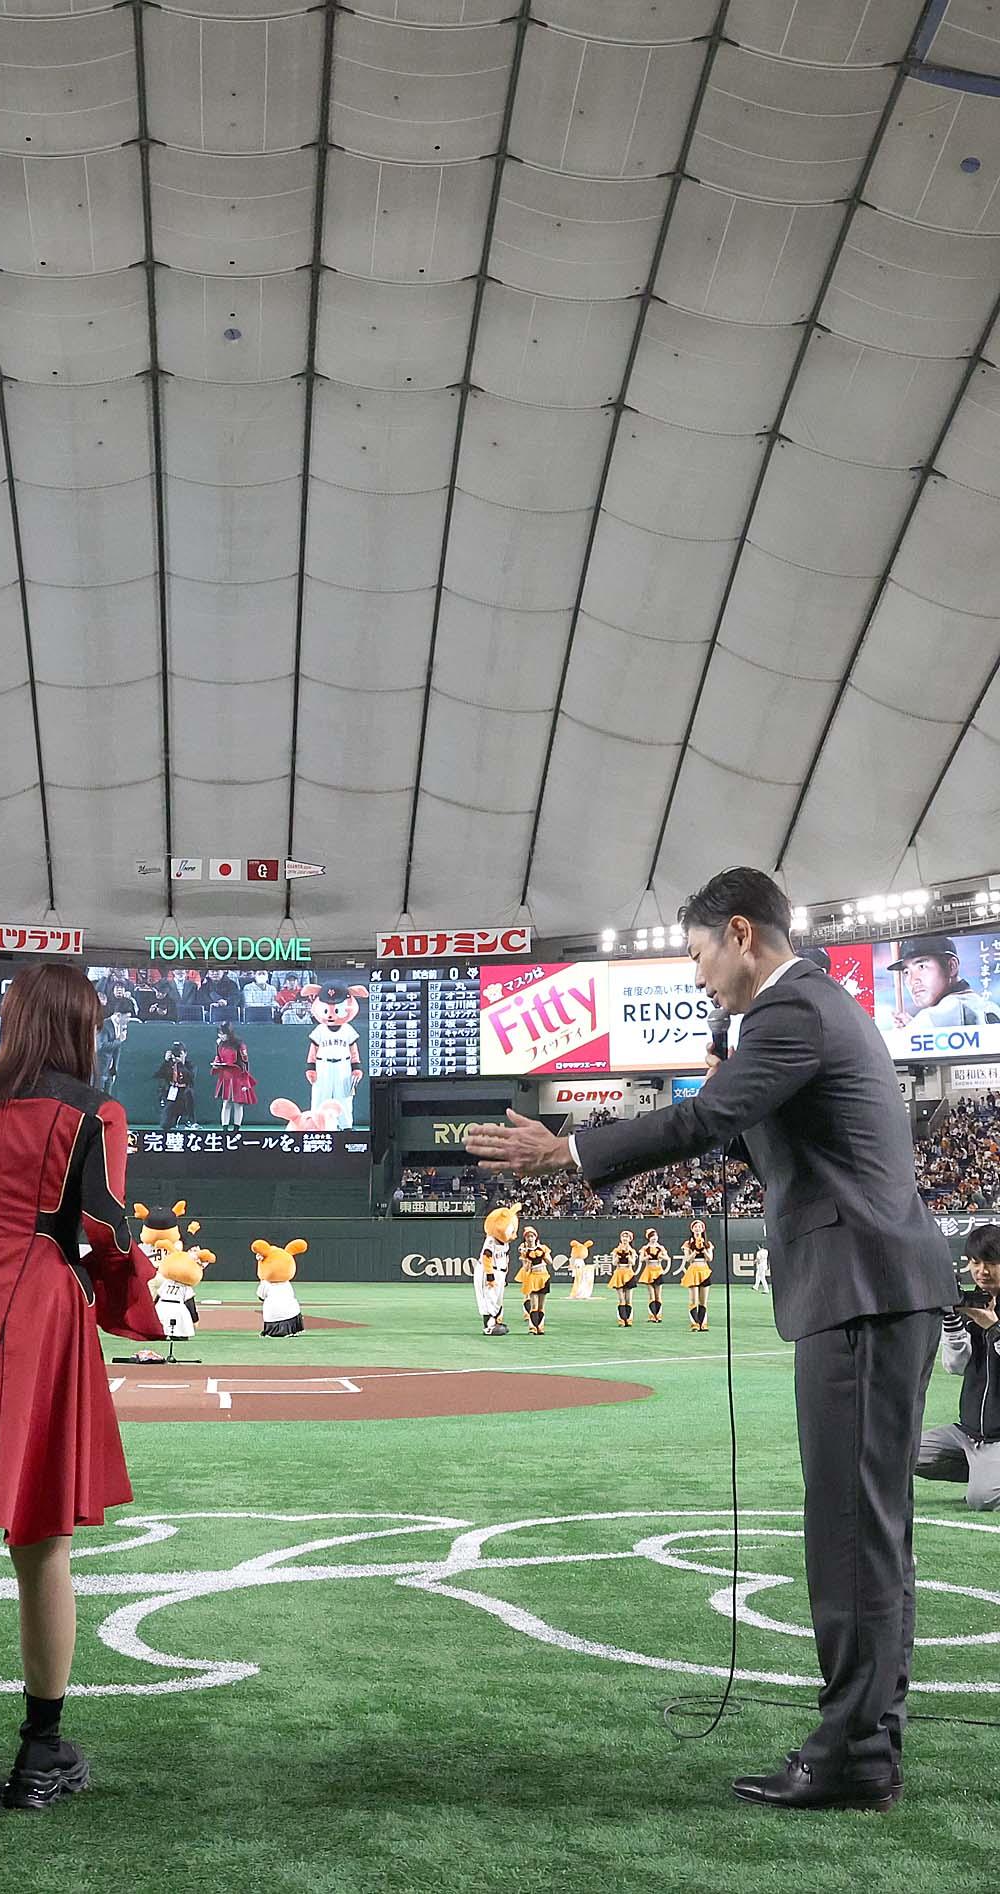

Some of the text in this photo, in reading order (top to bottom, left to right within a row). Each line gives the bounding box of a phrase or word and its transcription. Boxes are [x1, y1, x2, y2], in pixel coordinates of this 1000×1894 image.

[144, 936, 312, 962] TOKYO DOME
[381, 929, 527, 957] オロナミンC
[390, 969, 400, 982] 0
[449, 967, 459, 980] 0
[503, 966, 545, 991] マスクは
[488, 976, 597, 1056] Fitty
[643, 1028, 707, 1044] リノシー
[910, 1031, 980, 1052] SECOM
[556, 1089, 624, 1105] Denyo
[639, 1094, 651, 1105] 34
[143, 1132, 301, 1153] 完璧な生ビールを。
